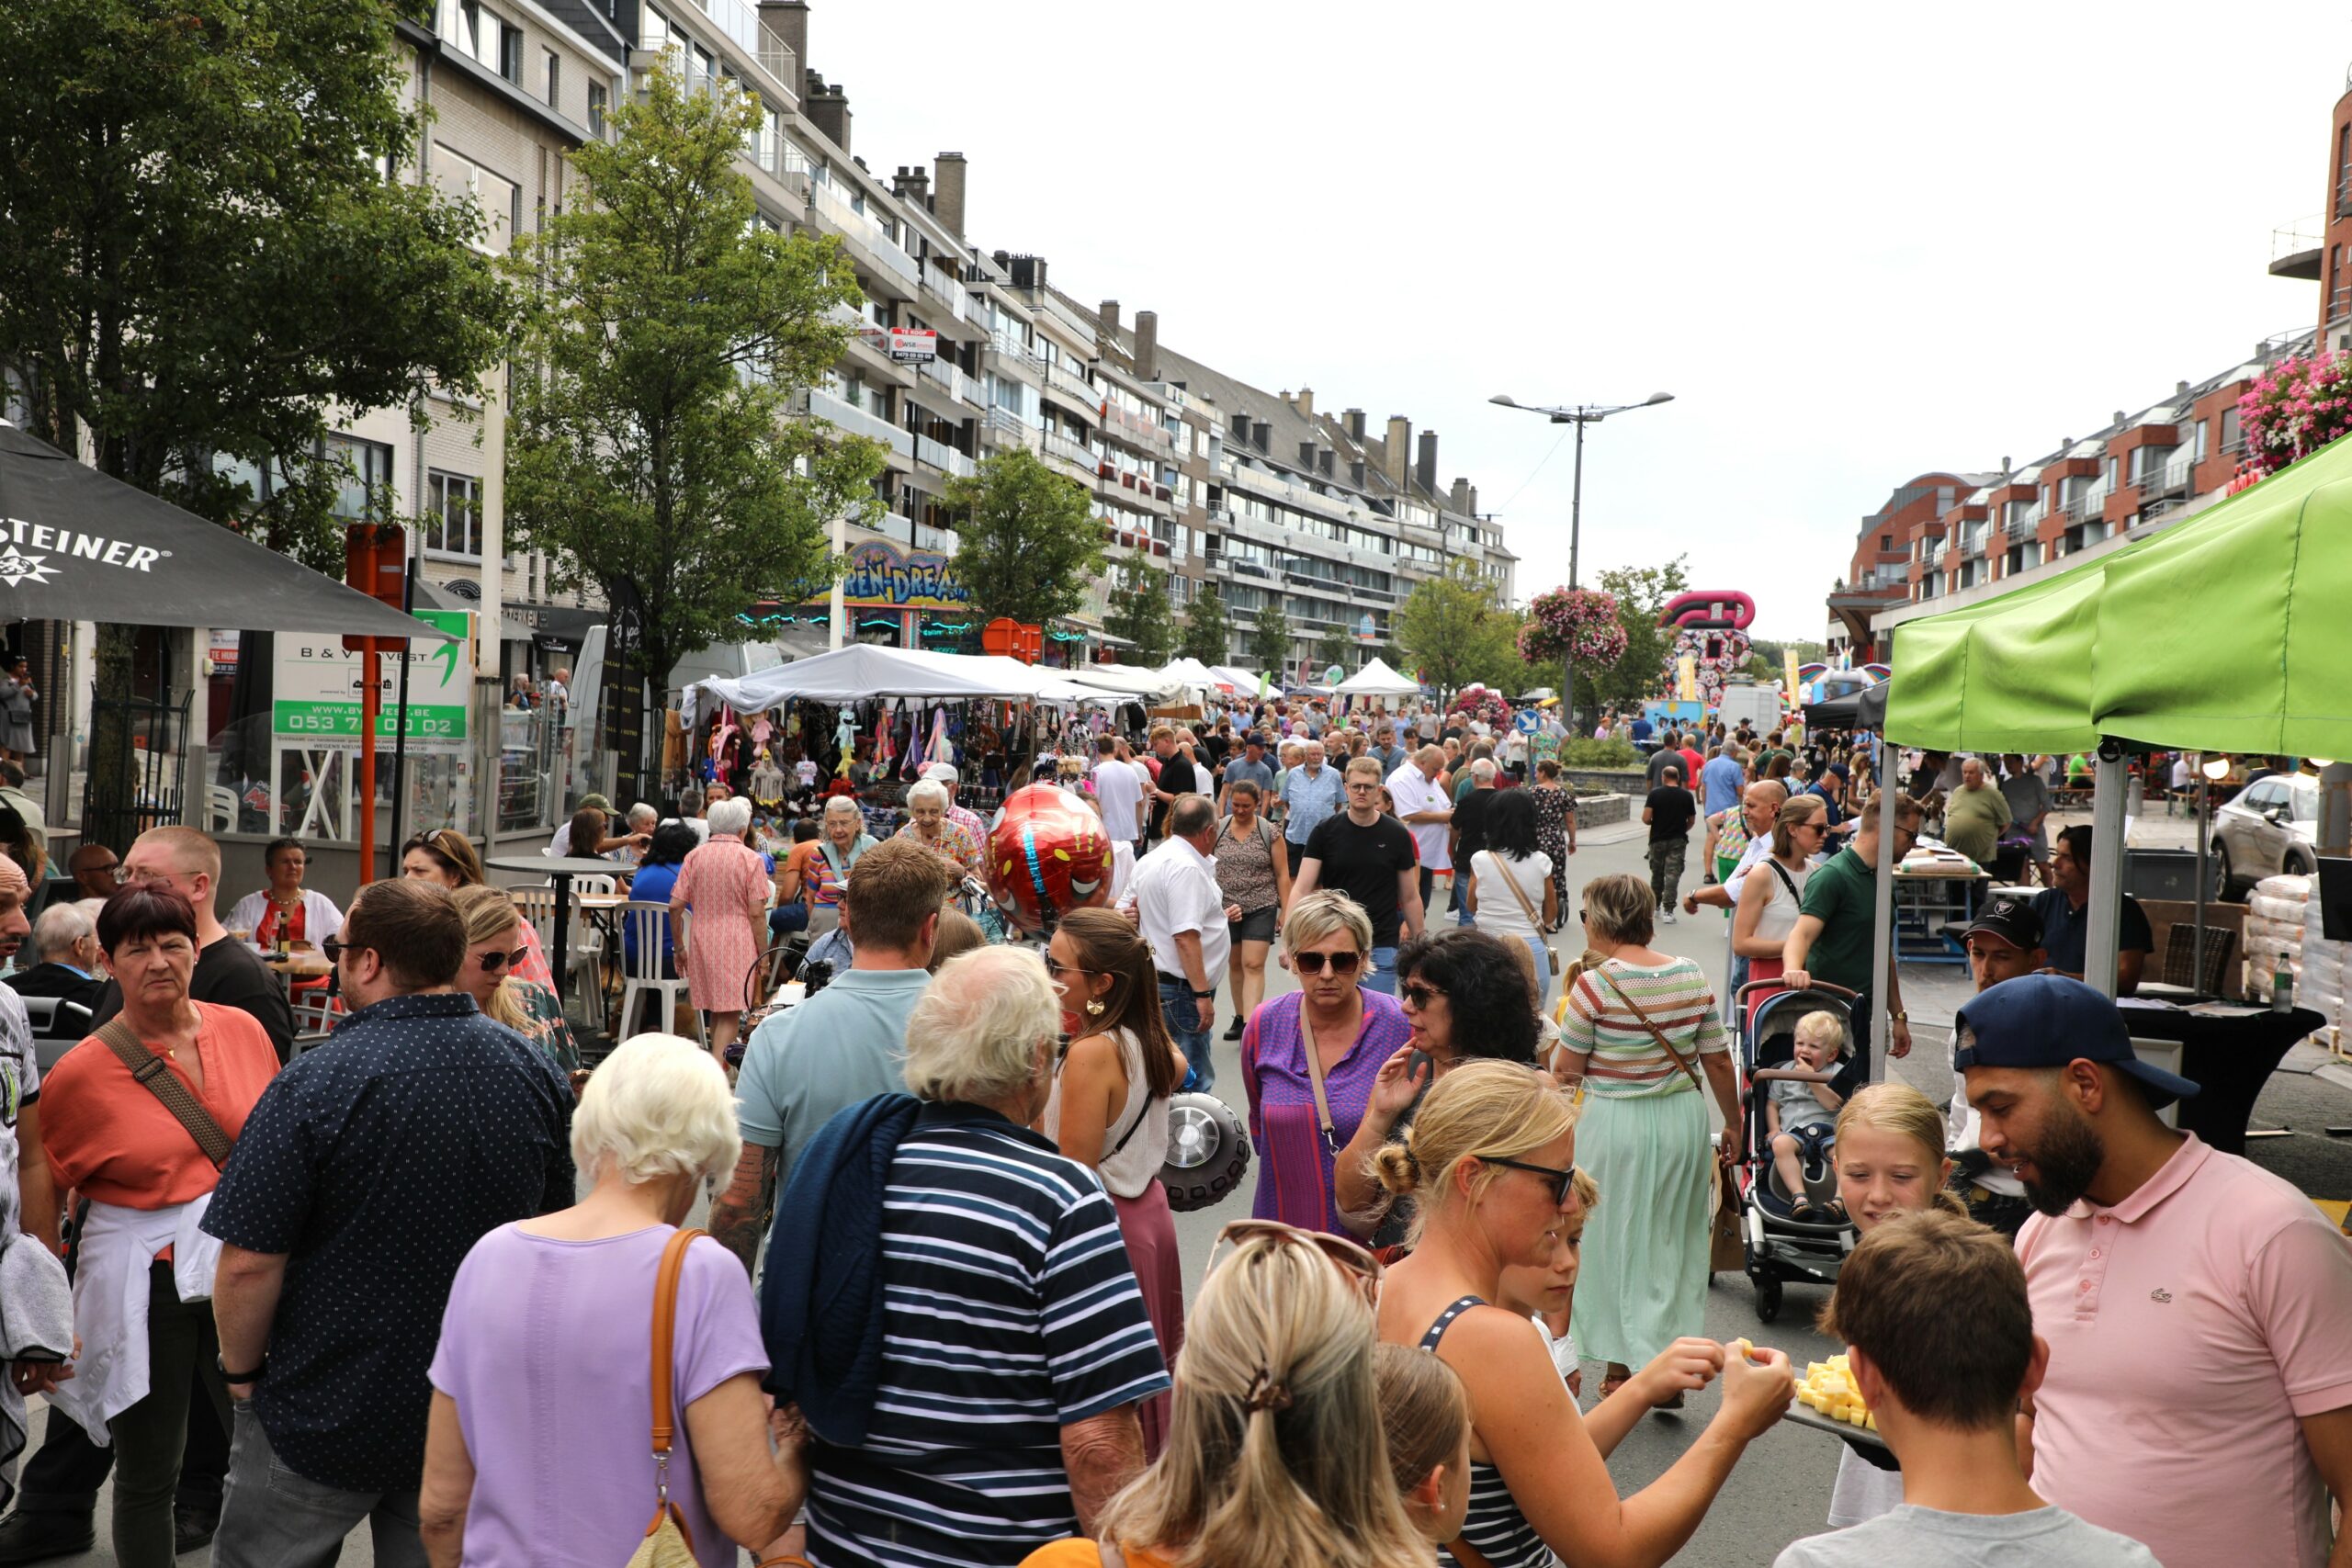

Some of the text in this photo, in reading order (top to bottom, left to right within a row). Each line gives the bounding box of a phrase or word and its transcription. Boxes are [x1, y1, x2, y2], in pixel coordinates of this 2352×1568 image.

[301, 648, 312, 658] B
[321, 649, 334, 659] &
[342, 649, 353, 659] V
[289, 716, 334, 729] 053
[423, 719, 451, 733] 02
